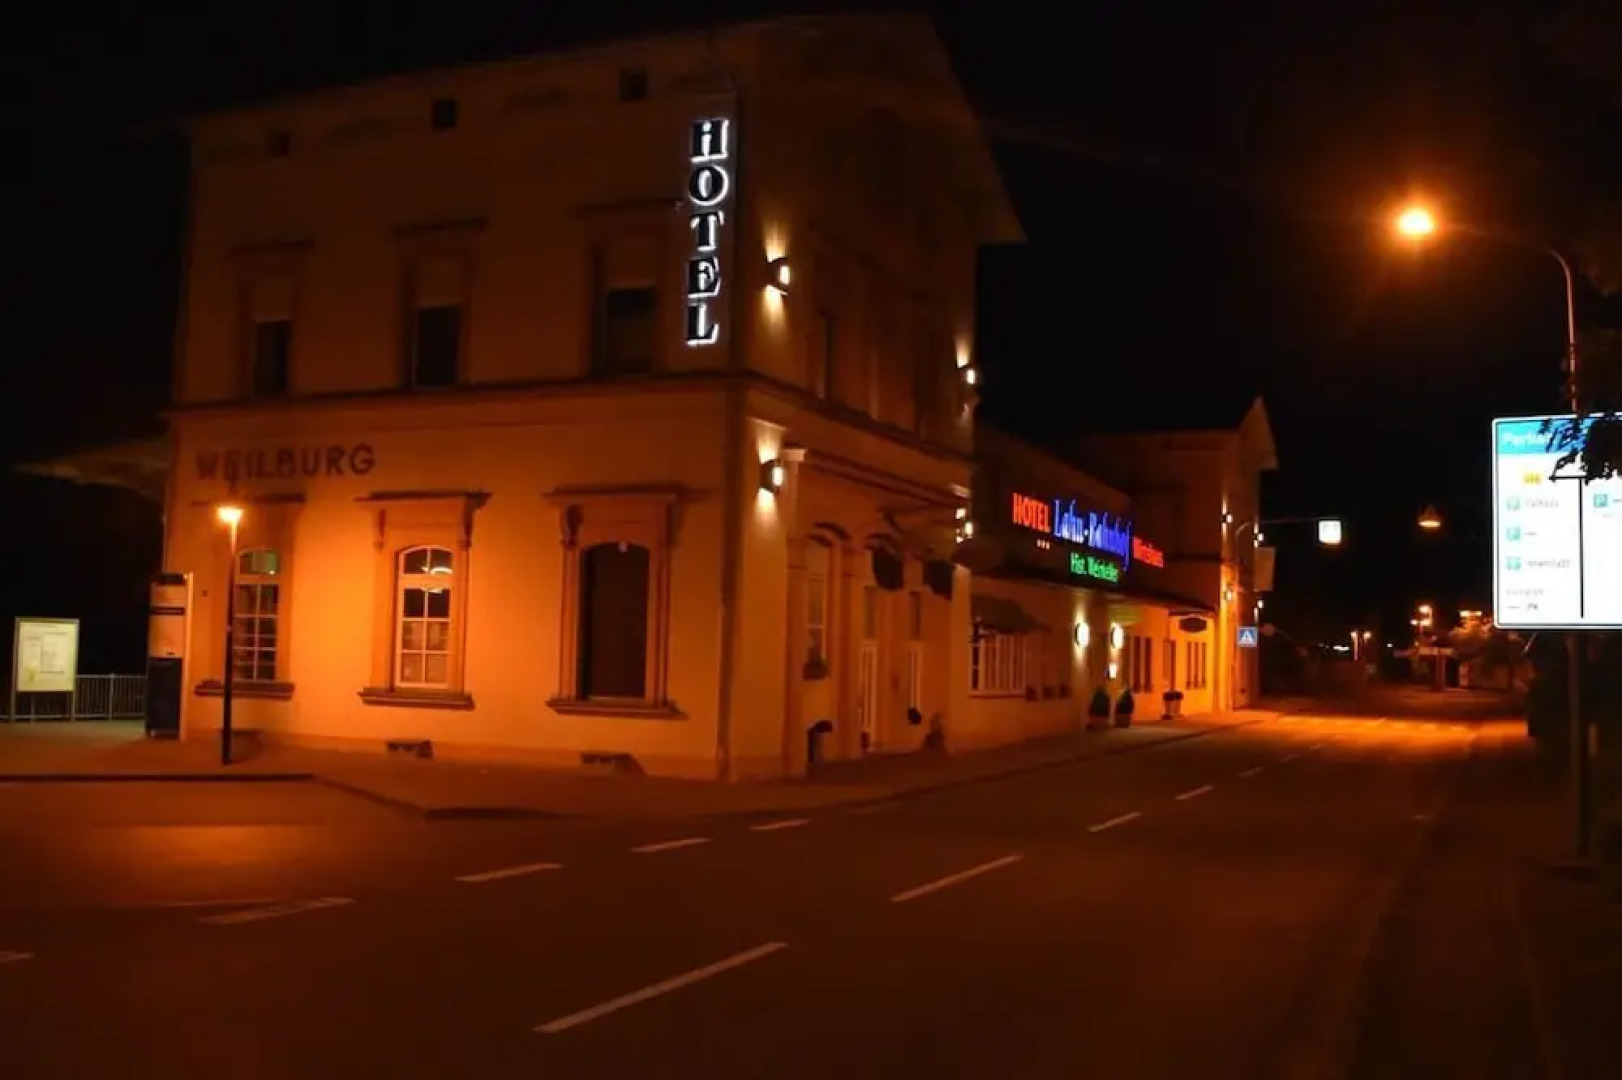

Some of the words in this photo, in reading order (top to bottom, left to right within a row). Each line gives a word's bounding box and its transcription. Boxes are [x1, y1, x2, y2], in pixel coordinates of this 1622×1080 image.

[687, 117, 729, 346] HOTEL
[196, 444, 376, 480] WEILBURG
[1012, 492, 1051, 533] HOTEL
